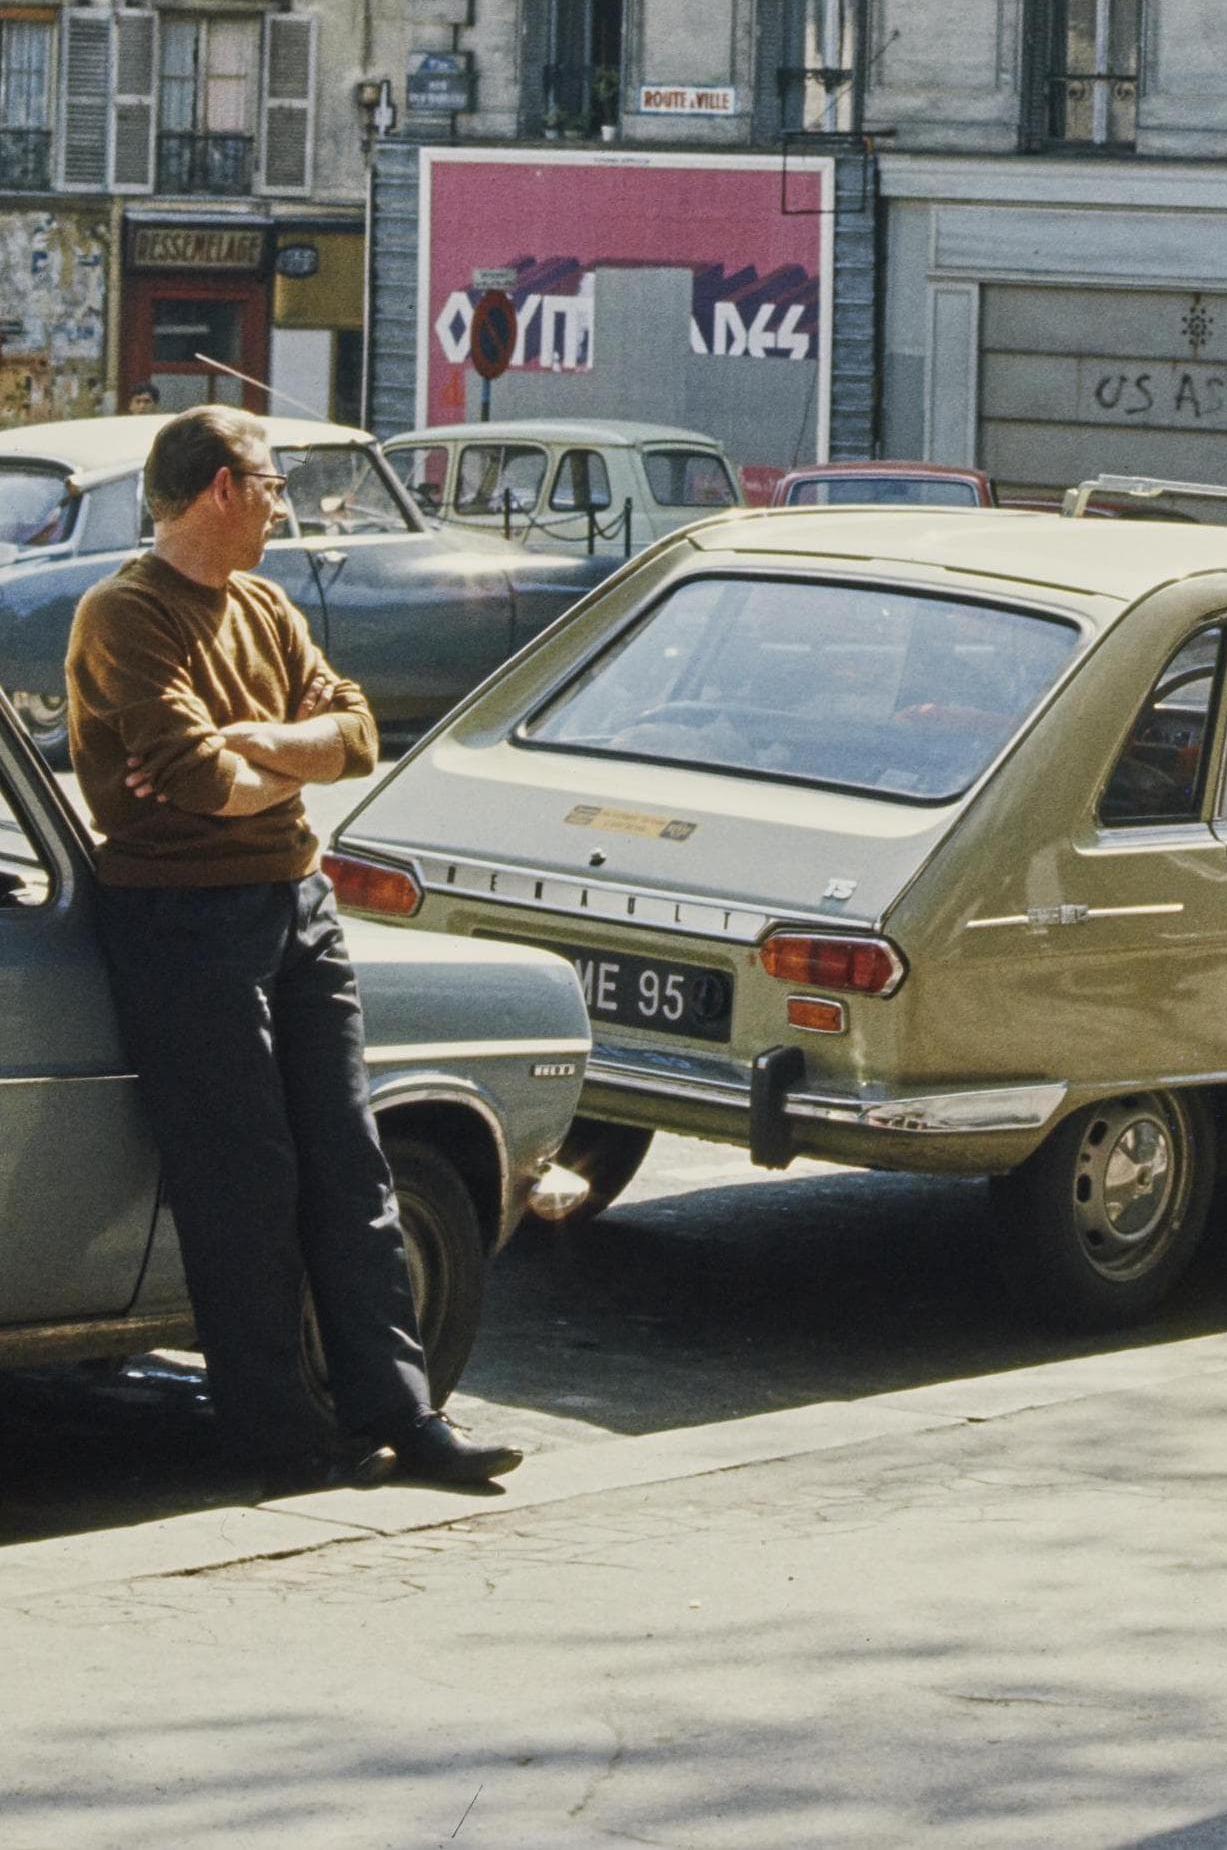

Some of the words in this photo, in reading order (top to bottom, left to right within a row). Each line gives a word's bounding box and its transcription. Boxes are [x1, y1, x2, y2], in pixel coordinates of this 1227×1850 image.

[644, 90, 687, 108] ROUTE
[696, 92, 730, 110] VILLE
[1094, 373, 1153, 416] US
[446, 865, 732, 931] RENAULT
[638, 969, 685, 1021] 95
